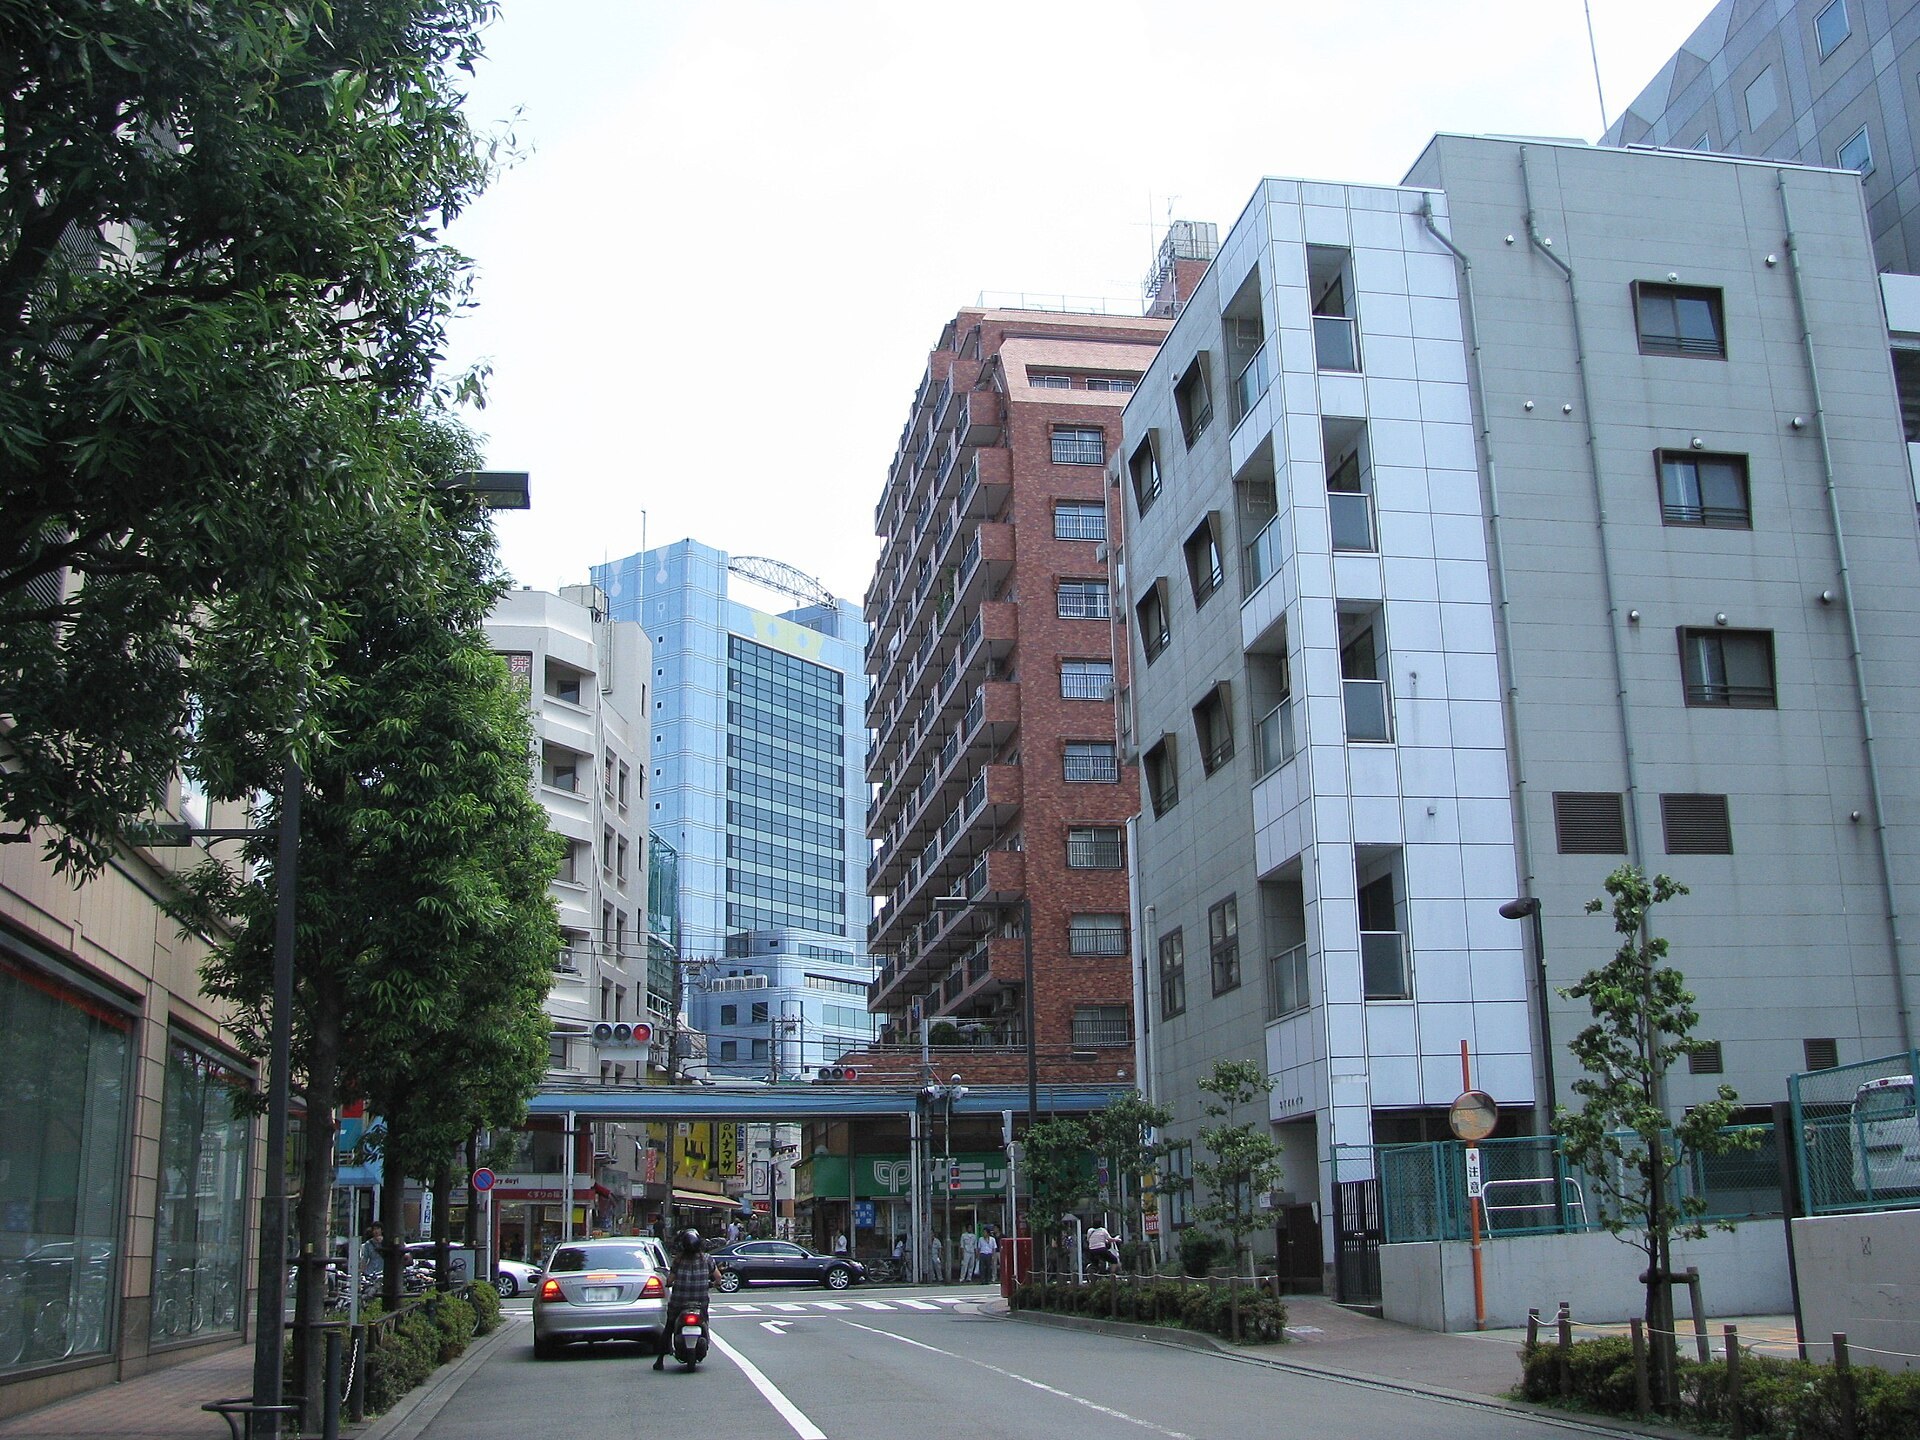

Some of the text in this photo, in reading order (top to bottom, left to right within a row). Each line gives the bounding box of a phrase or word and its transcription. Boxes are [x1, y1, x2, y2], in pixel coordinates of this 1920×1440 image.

[721, 1123, 734, 1172] のハナマサ
[1469, 1166, 1480, 1194] 注意
